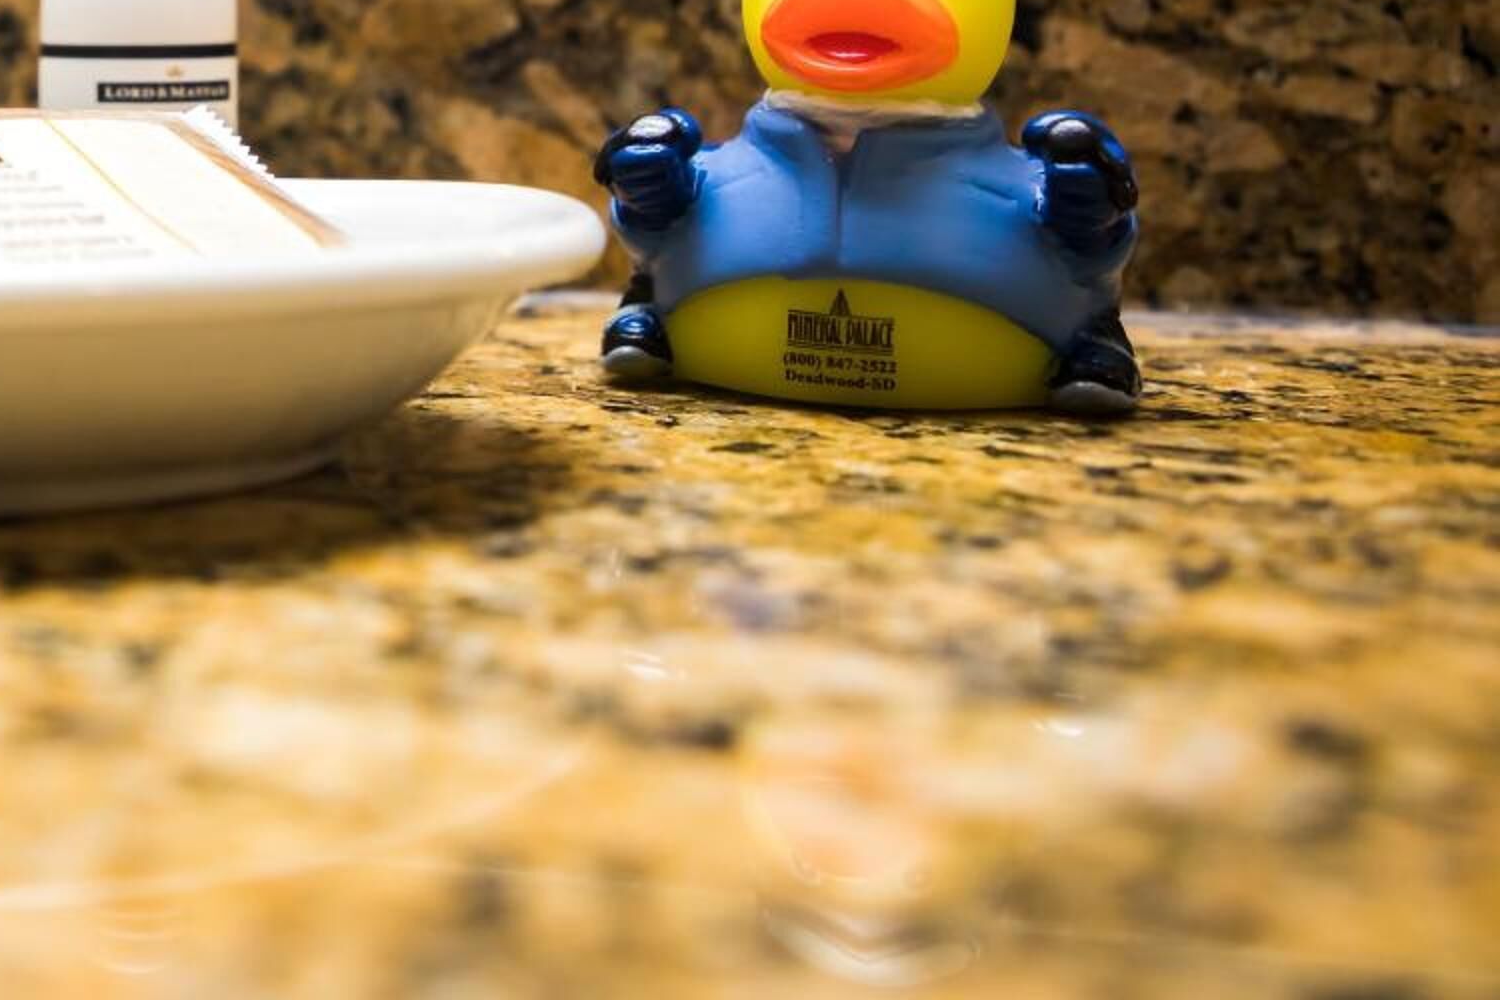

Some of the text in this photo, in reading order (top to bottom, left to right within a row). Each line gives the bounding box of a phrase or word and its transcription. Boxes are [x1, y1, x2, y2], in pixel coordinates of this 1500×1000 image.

[788, 313, 895, 348] MINERAL PALACE
[783, 352, 897, 374] (800) 847-2522
[785, 370, 896, 391] Deadwood-SD
